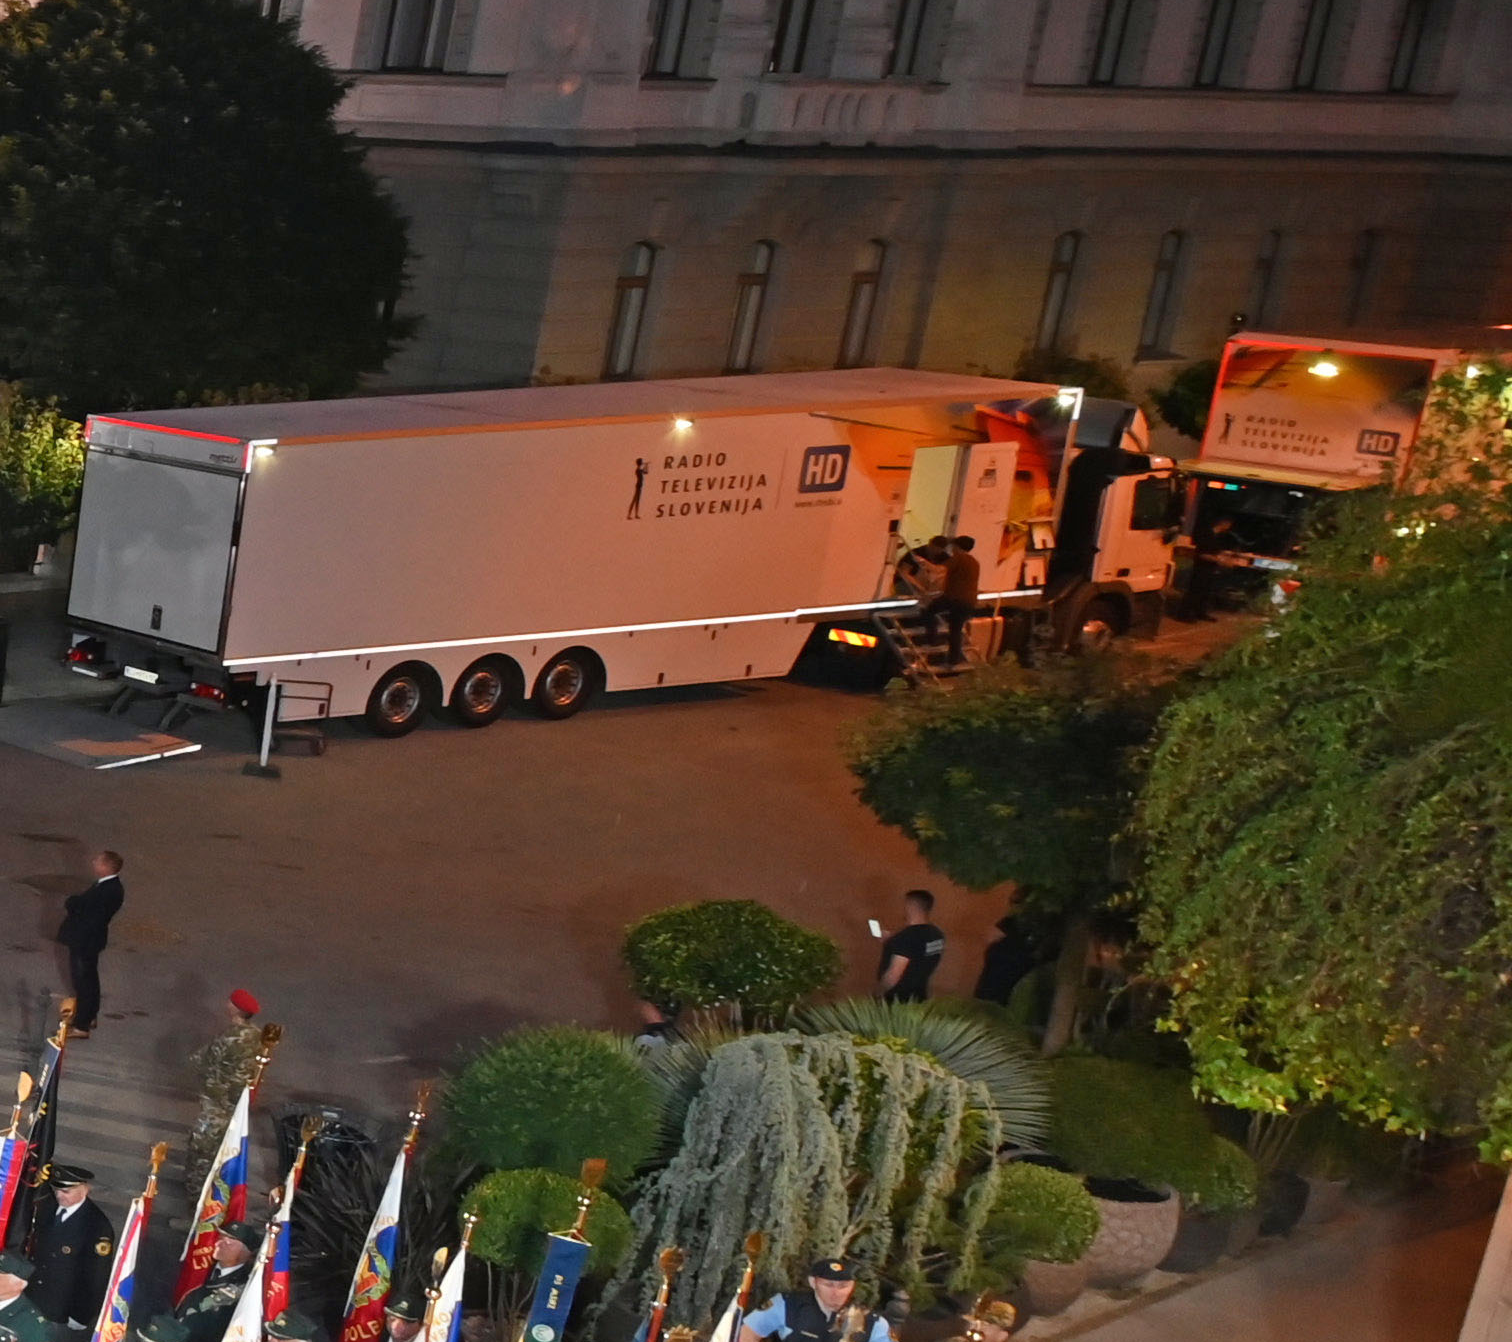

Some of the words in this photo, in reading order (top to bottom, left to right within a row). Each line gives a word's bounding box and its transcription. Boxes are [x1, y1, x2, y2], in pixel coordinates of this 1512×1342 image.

[664, 453, 727, 470] RADIO
[805, 453, 843, 485] HD
[660, 474, 768, 495] TELEVIZIJA
[655, 498, 763, 519] SLOVENIJA
